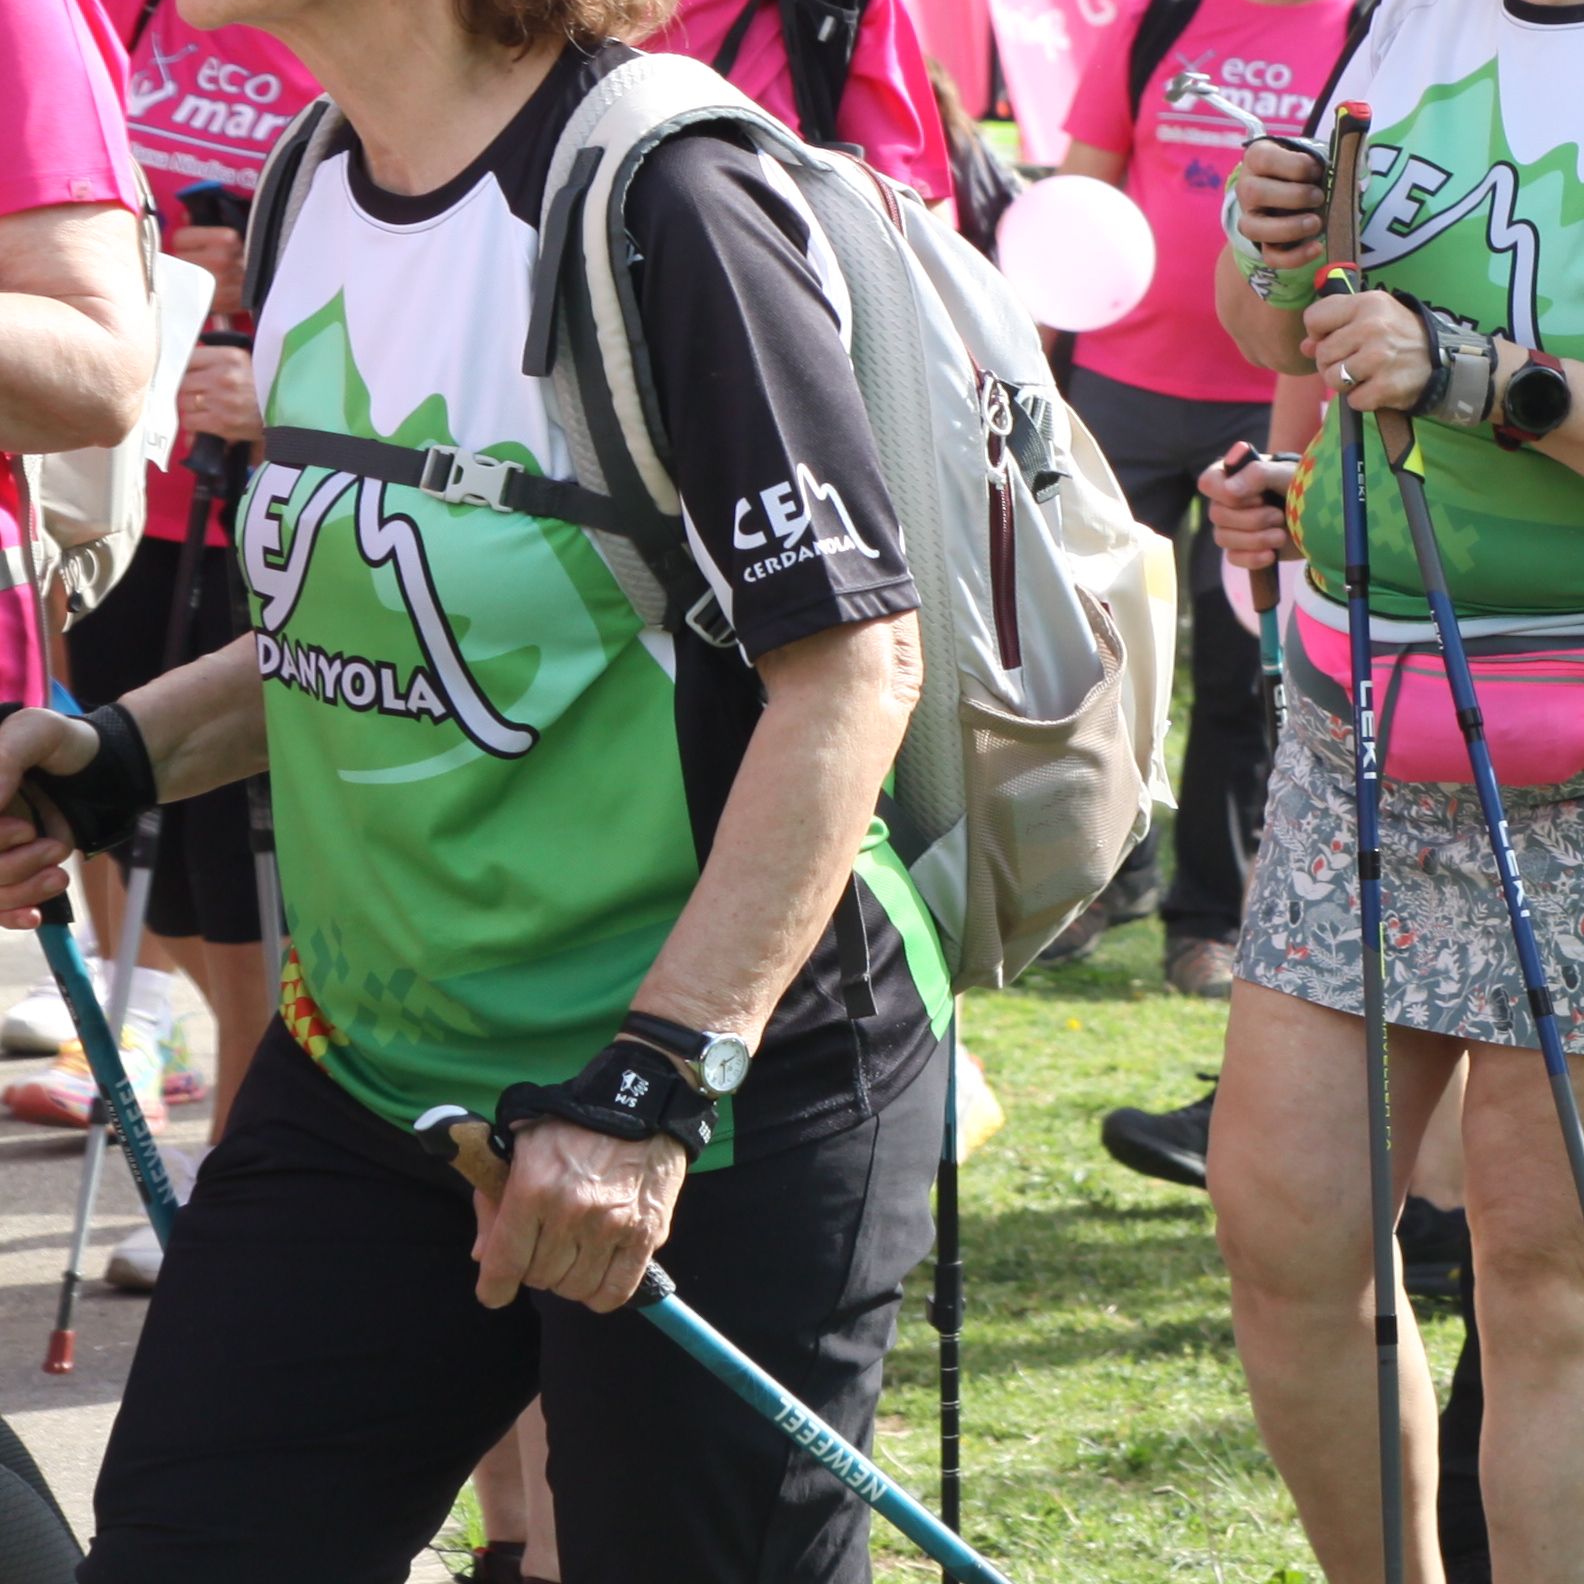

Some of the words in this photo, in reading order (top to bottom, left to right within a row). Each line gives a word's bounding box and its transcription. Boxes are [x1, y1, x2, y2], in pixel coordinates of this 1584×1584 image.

[196, 56, 282, 104] eco
[1221, 57, 1294, 90] eco
[171, 92, 292, 144] mar
[1359, 679, 1378, 780] LEKI
[114, 1077, 176, 1205] NEWFEEL
[773, 1396, 889, 1503] NEWFEEL
